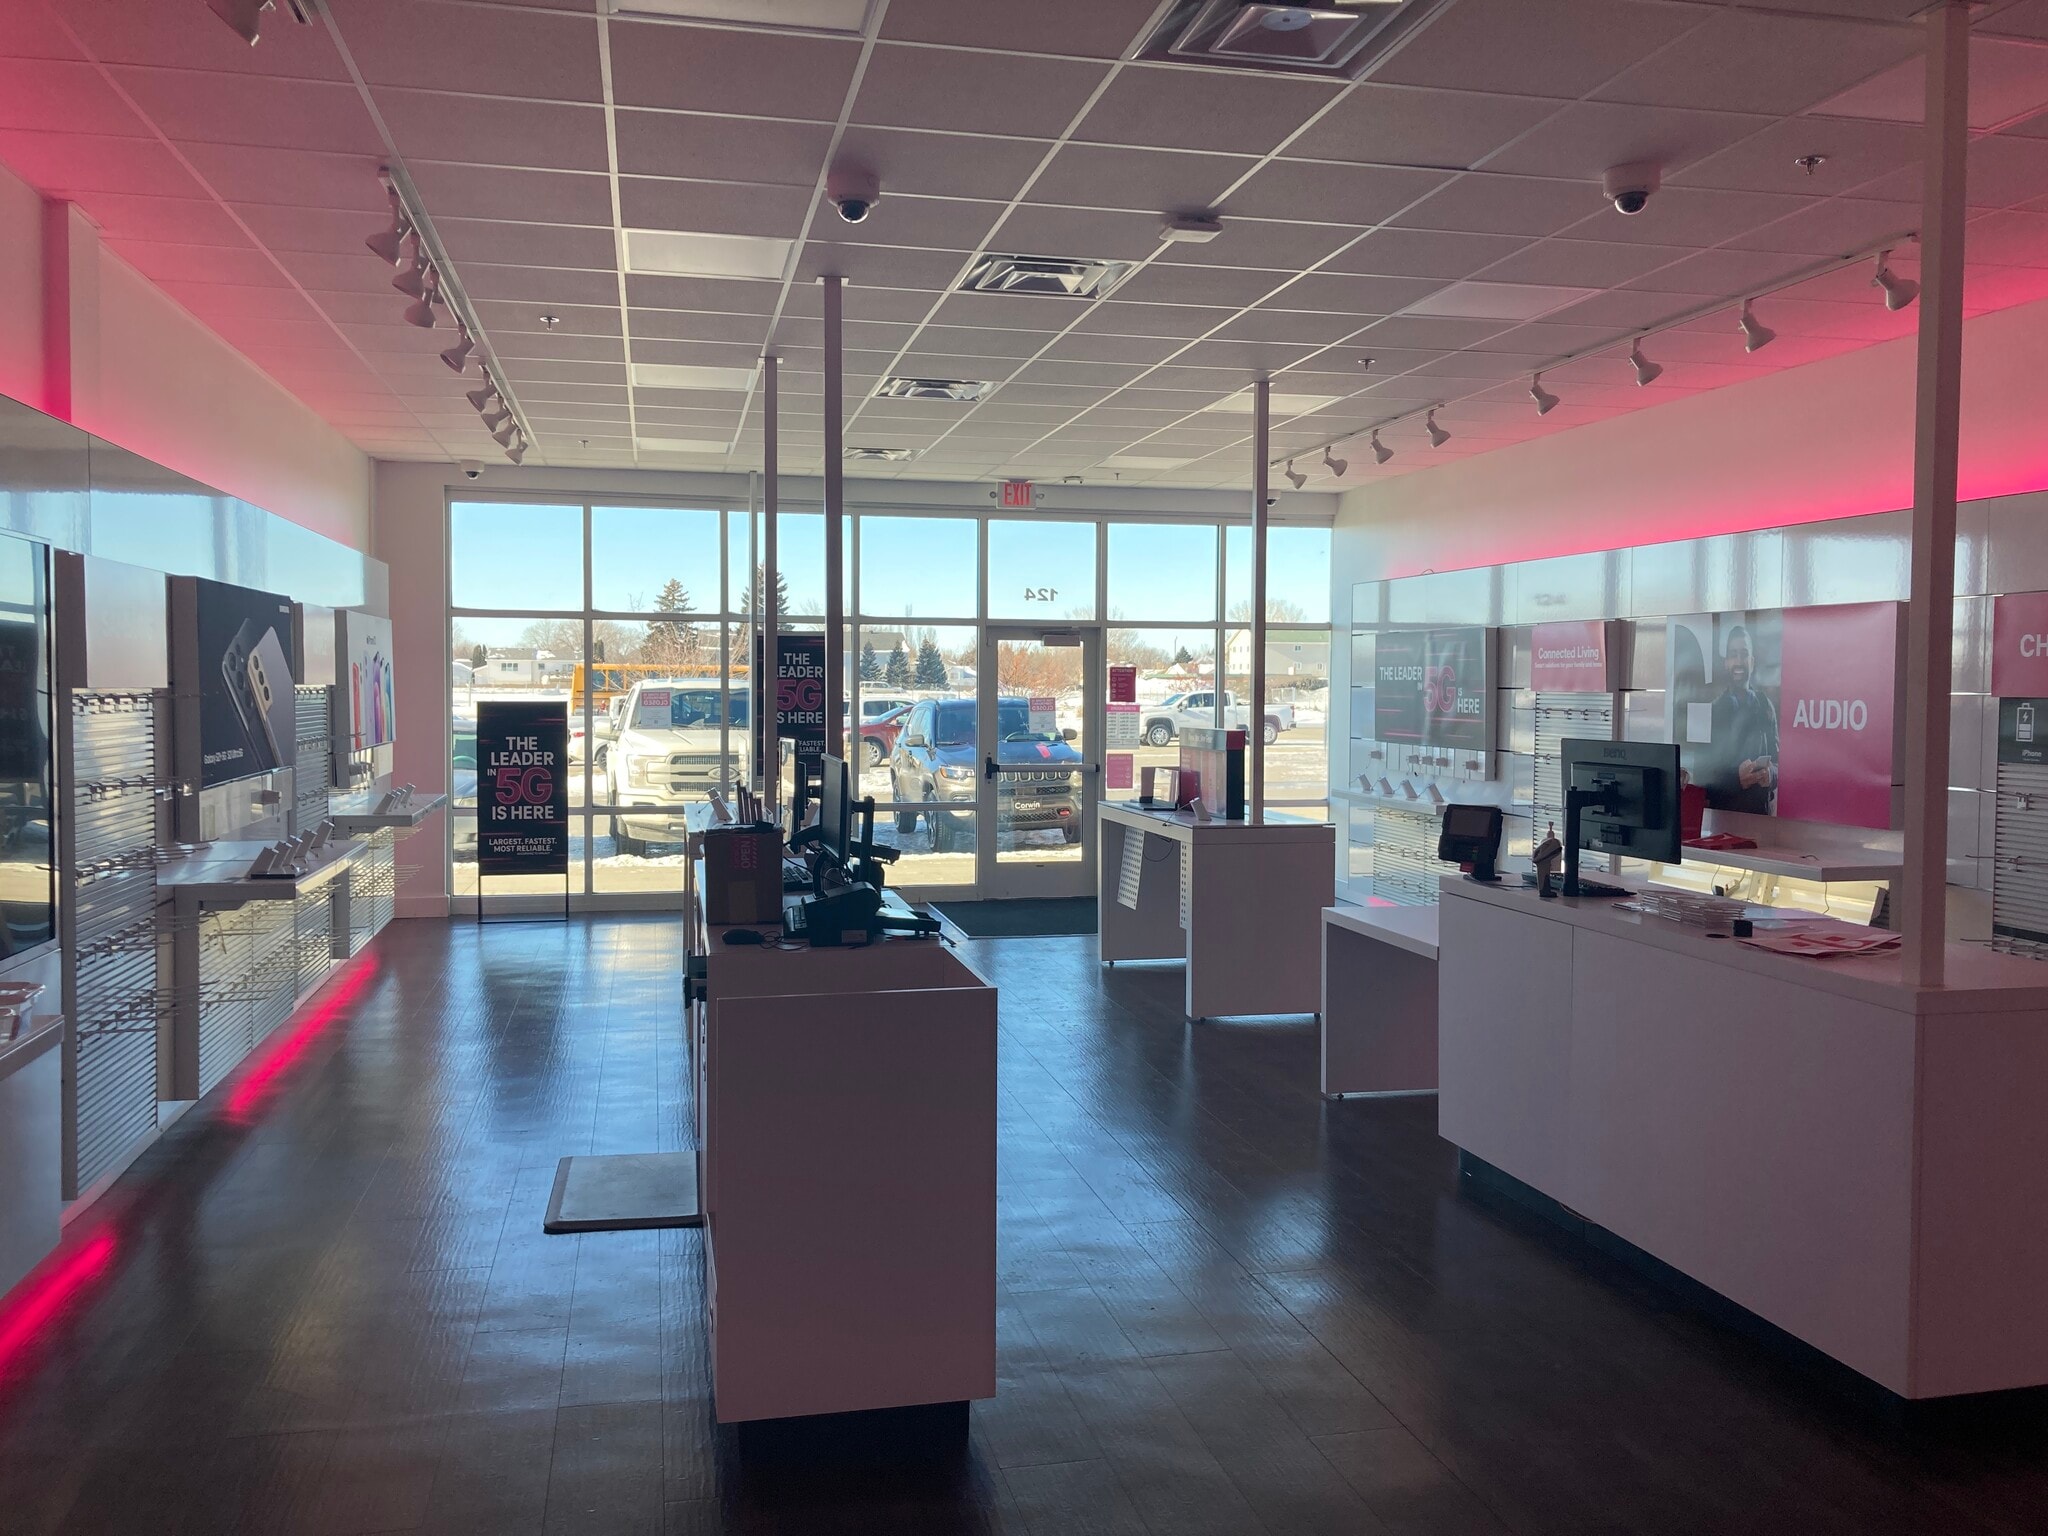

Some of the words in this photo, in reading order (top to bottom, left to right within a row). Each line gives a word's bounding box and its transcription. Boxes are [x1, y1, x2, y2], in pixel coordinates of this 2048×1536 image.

[1004, 483, 1031, 505] EXIT
[2020, 634, 2048, 657] CH
[783, 653, 810, 665] THE
[1538, 647, 1576, 659] Connected
[1577, 646, 1599, 660] Living
[777, 666, 823, 678] EADER
[1380, 666, 1393, 680] THE
[1394, 666, 1422, 681] LEADER
[1417, 682, 1423, 691] IN
[1423, 665, 1456, 713] 5G
[1457, 687, 1463, 696] IS
[777, 679, 822, 711] 5G
[1457, 698, 1480, 713] HERE
[788, 712, 823, 724] HERE
[1792, 699, 1868, 731] AUDIO
[505, 736, 538, 750] THE
[490, 752, 554, 766] LEADER
[487, 768, 497, 776] IN
[495, 766, 553, 804] 5G
[491, 805, 507, 820] IS
[511, 805, 554, 820] HERE
[1014, 801, 1041, 811] Corwin
[488, 838, 524, 846] LARGEST.
[525, 837, 558, 845] FASTEST.
[493, 845, 515, 853] MOST
[516, 844, 553, 852] RELIABLE.
